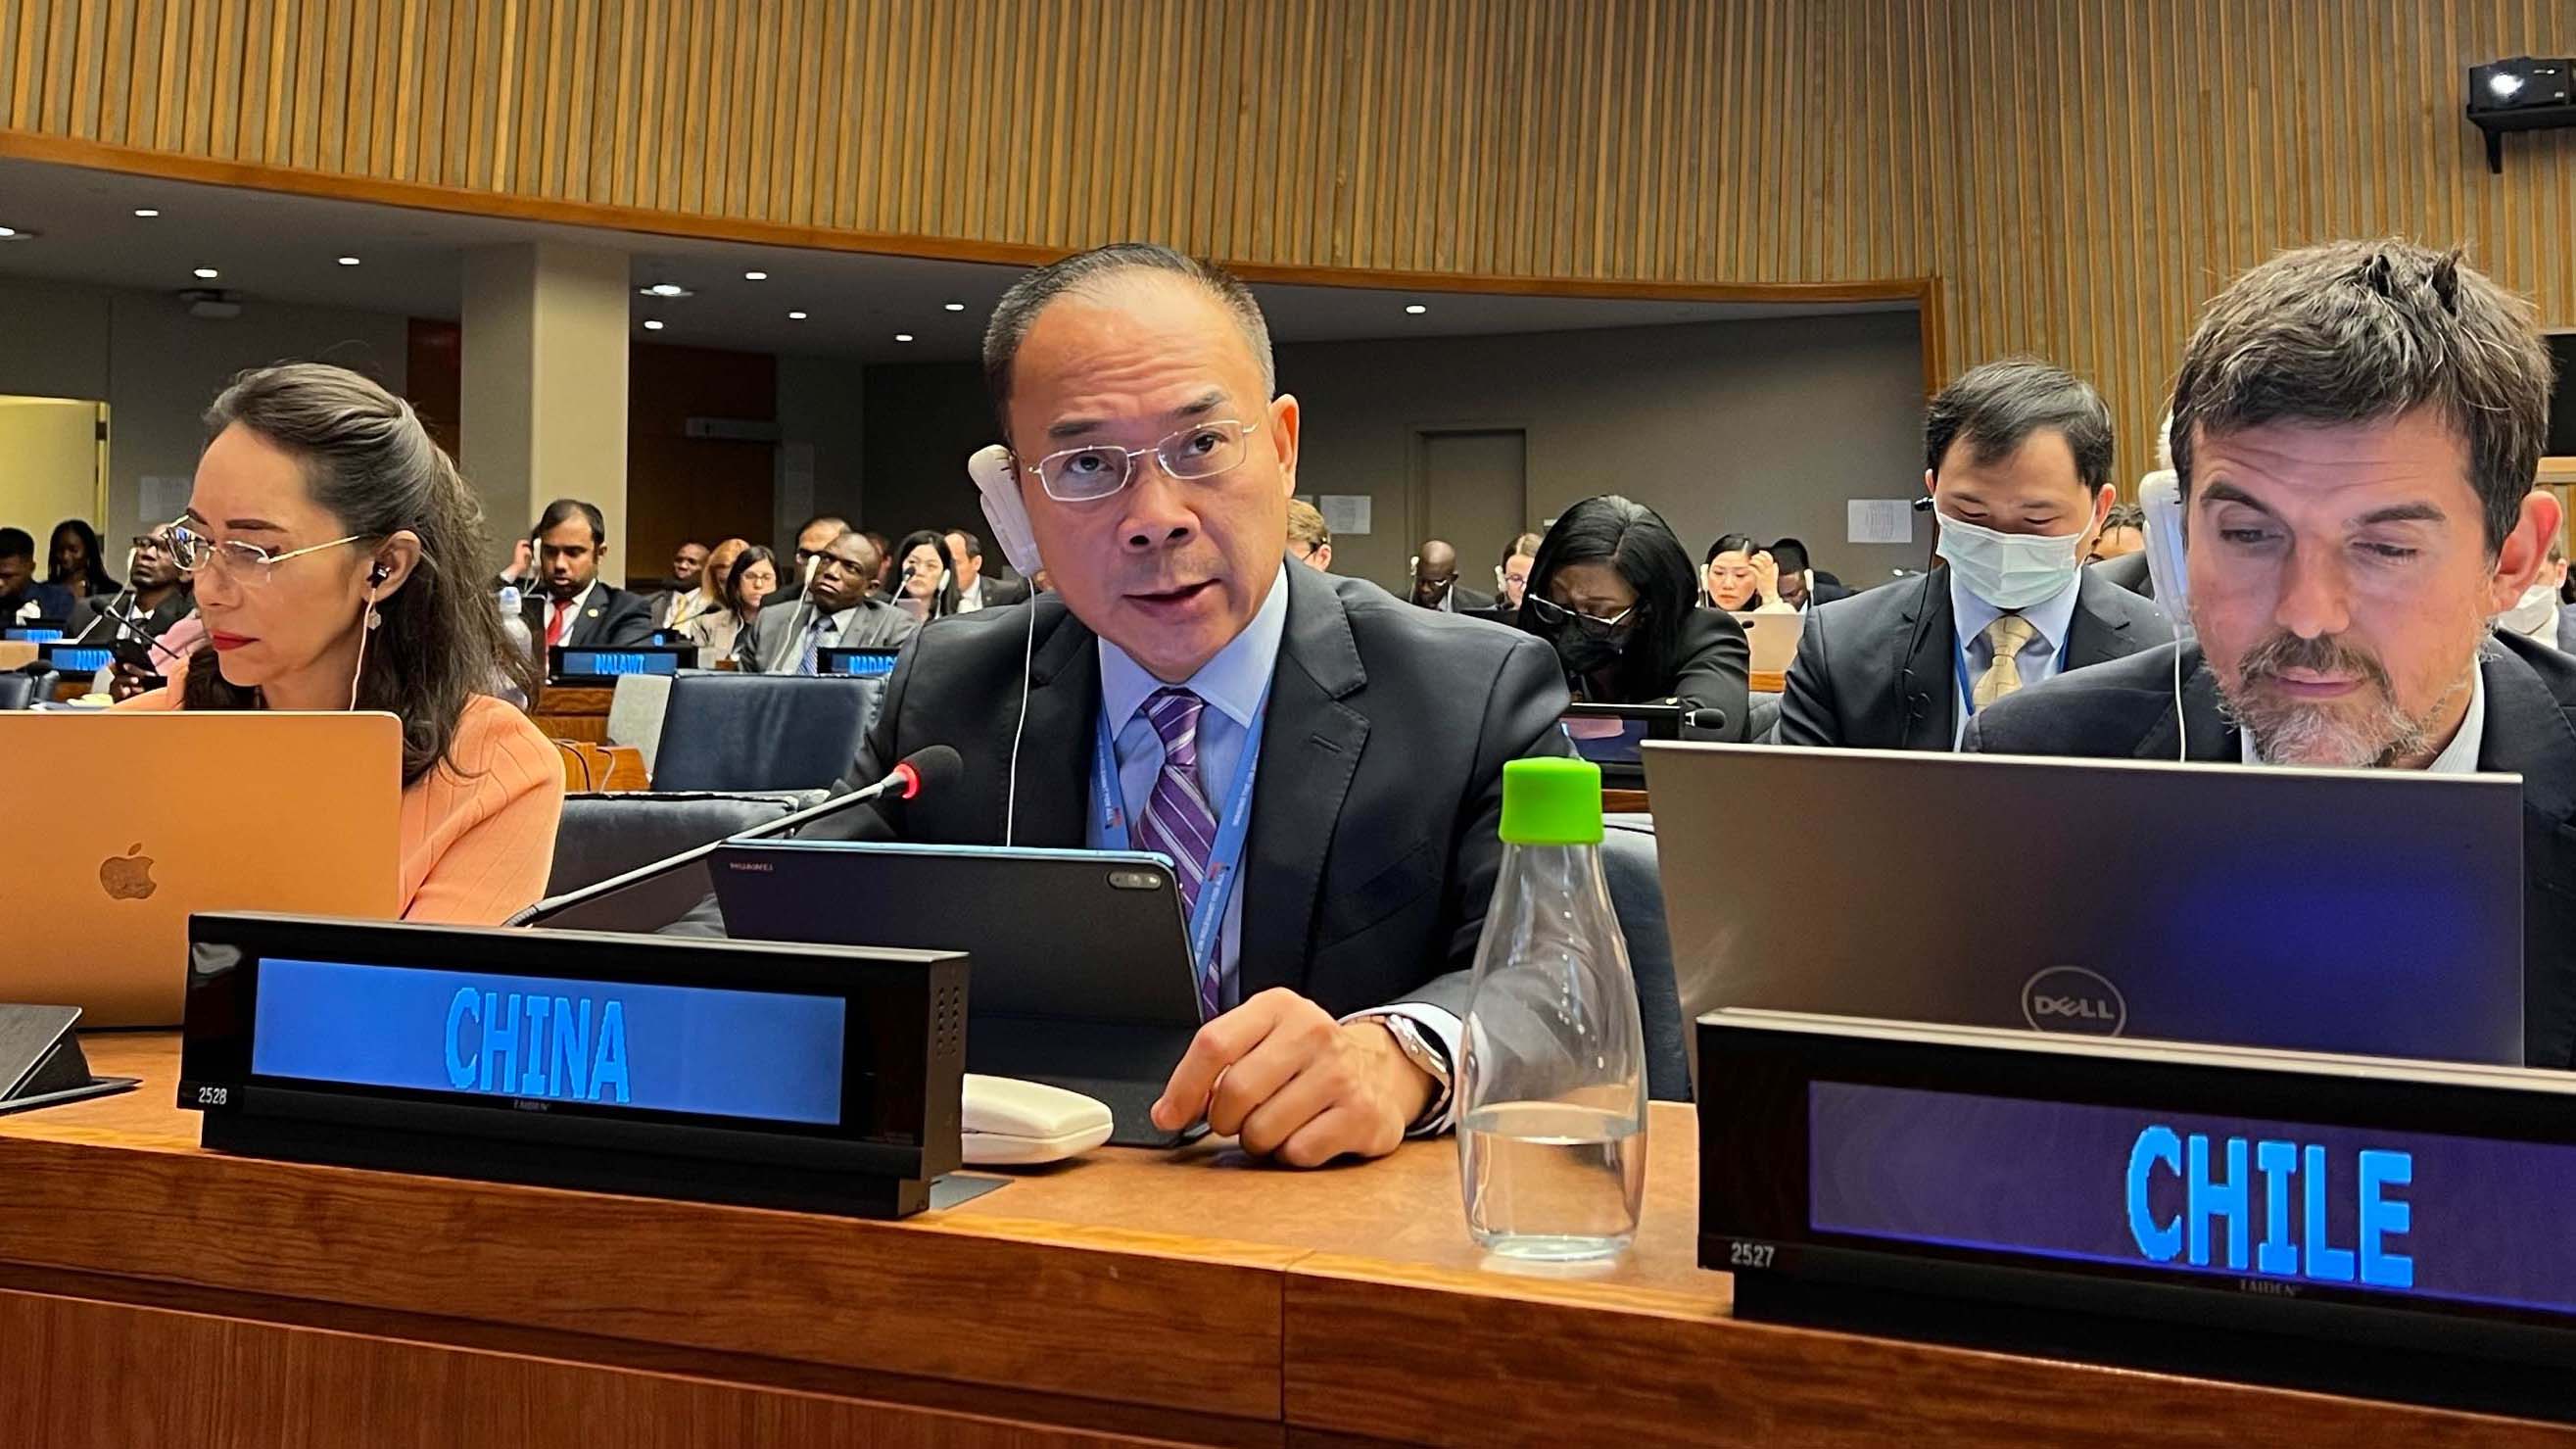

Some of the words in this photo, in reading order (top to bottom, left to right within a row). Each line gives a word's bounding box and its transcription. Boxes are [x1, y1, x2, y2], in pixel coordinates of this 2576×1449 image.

[2034, 995, 2115, 1019] DELL
[446, 988, 629, 1102] CHINA
[198, 1087, 227, 1104] 2528
[2126, 1125, 2412, 1288] CHILE
[1731, 1241, 1775, 1268] 2527
